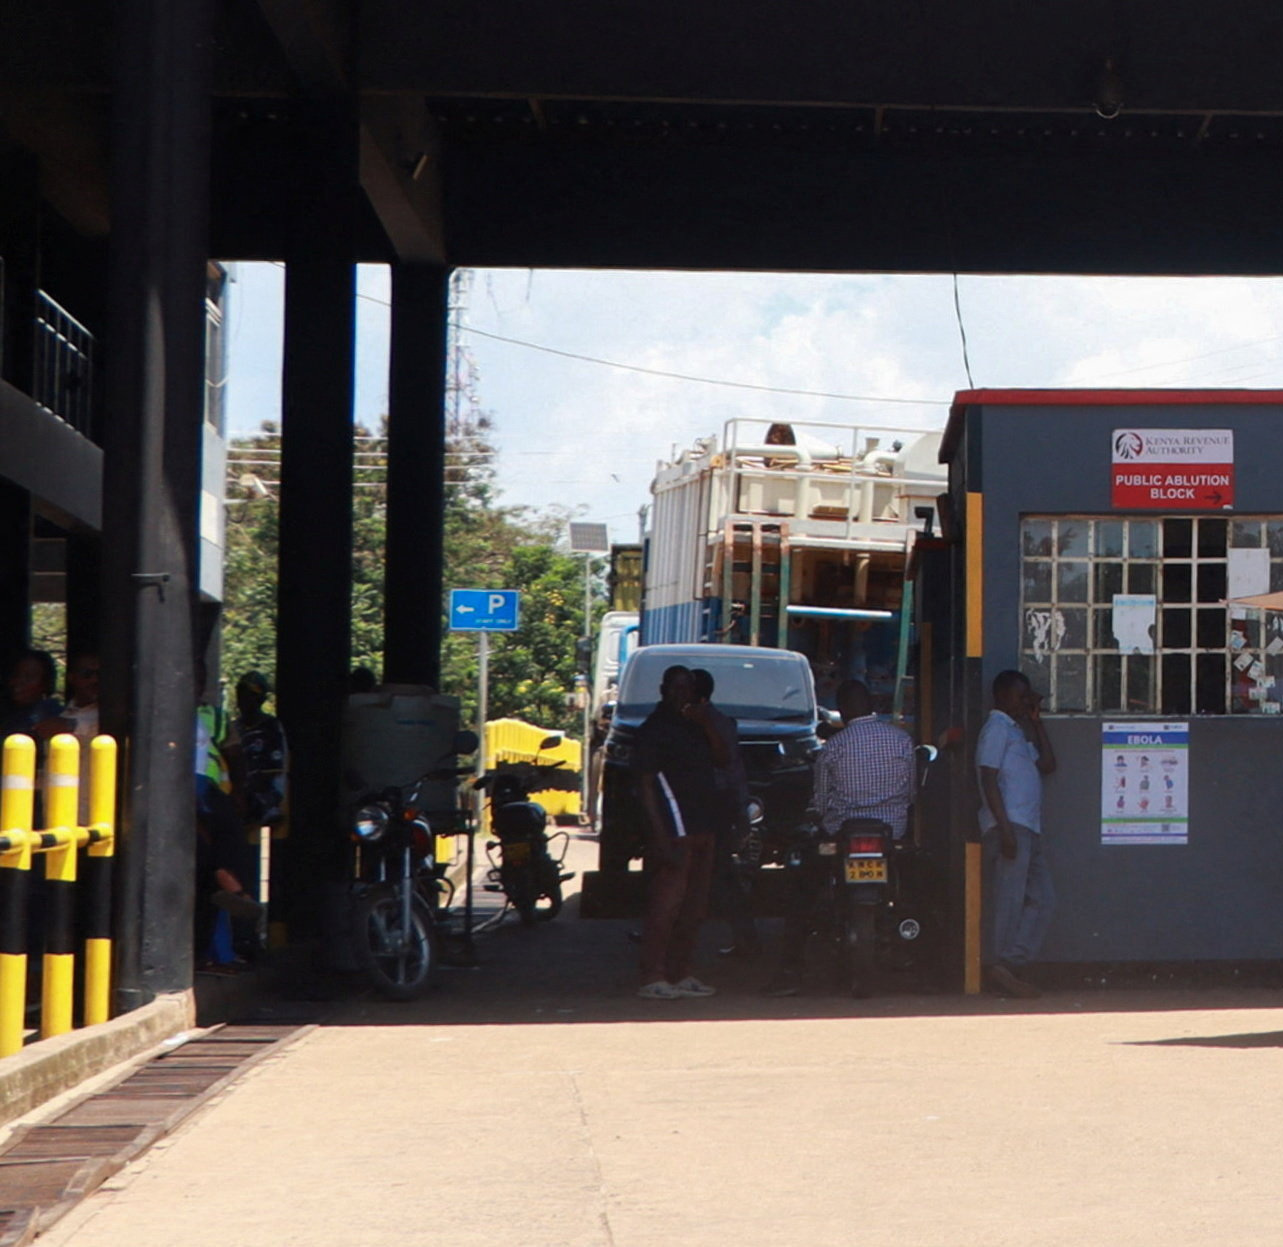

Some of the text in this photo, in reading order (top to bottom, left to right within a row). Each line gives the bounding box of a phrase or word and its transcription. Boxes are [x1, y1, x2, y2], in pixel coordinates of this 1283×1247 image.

[1145, 436, 1230, 446] KENYA REVENUE
[1145, 446, 1204, 455] AUTHORITY
[1115, 474, 1230, 486] PUBLIC ABLUTION
[1150, 488, 1195, 499] BLOCK
[488, 594, 505, 615] P
[1127, 734, 1164, 745] EBOLA
